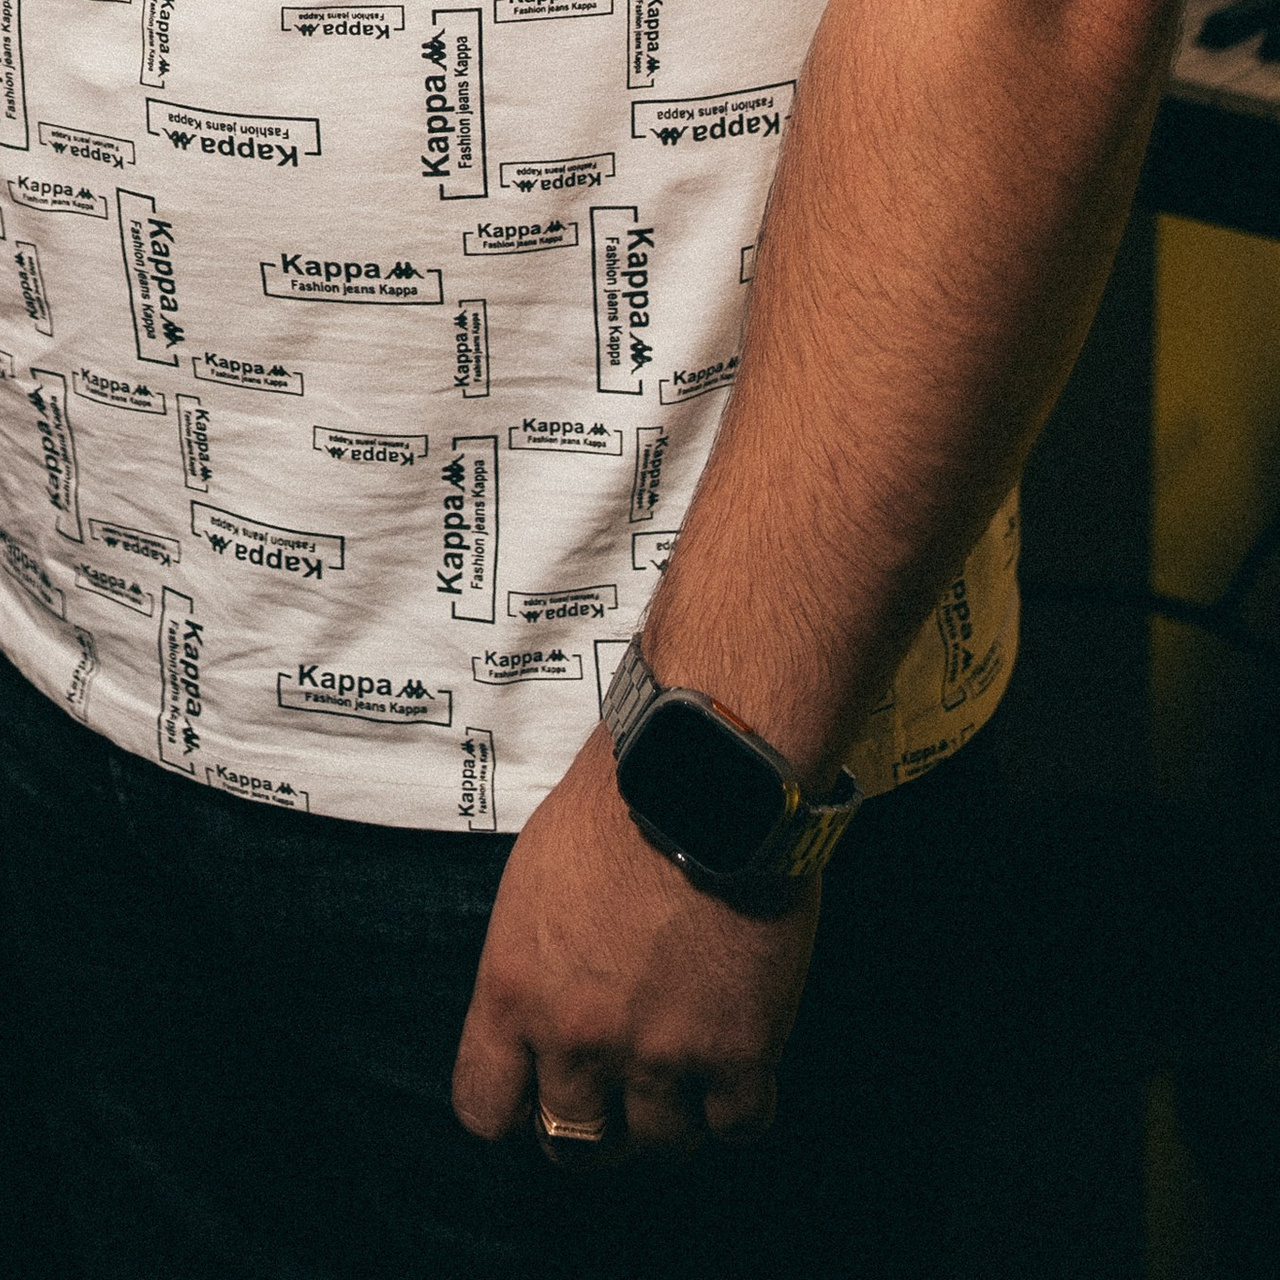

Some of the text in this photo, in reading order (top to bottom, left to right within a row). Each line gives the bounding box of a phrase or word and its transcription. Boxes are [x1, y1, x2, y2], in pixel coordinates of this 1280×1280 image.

[323, 24, 390, 40] Kappa
[454, 35, 474, 169] Fashion jeans Kappa
[168, 113, 290, 140] Fashion jeans Kappa
[421, 74, 455, 178] Kappa
[692, 112, 781, 143] Kappa
[70, 144, 124, 169] Kappa
[201, 135, 299, 168] Kappa
[18, 175, 73, 197] Kappa
[541, 171, 602, 191] Kappa
[477, 222, 542, 241] Kappa
[147, 217, 179, 314] Kappa
[281, 253, 382, 283] Kappa
[621, 227, 655, 329] Kappa
[20, 269, 39, 320] Kappa
[291, 279, 418, 297] Fashion jeans Kappa
[604, 236, 624, 366] Fashion jeans Kappa
[204, 352, 266, 376] Kappa
[454, 331, 473, 387] Kappa
[81, 368, 131, 394] Kappa
[673, 363, 724, 386] Kappa
[195, 408, 211, 462] Kappa
[522, 418, 585, 436] Kappa
[351, 448, 414, 466] Kappa
[651, 435, 669, 488] Kappa
[470, 459, 489, 590] Fashion jeans Kappa
[121, 539, 171, 567] Kappa
[437, 494, 472, 594] Kappa
[235, 543, 323, 579] Kappa
[547, 604, 605, 621] Kappa
[180, 619, 204, 718] Kappa
[485, 650, 544, 668] Kappa
[298, 664, 393, 697] Kappa
[215, 764, 273, 792] Kappa
[458, 760, 476, 818] Kappa
